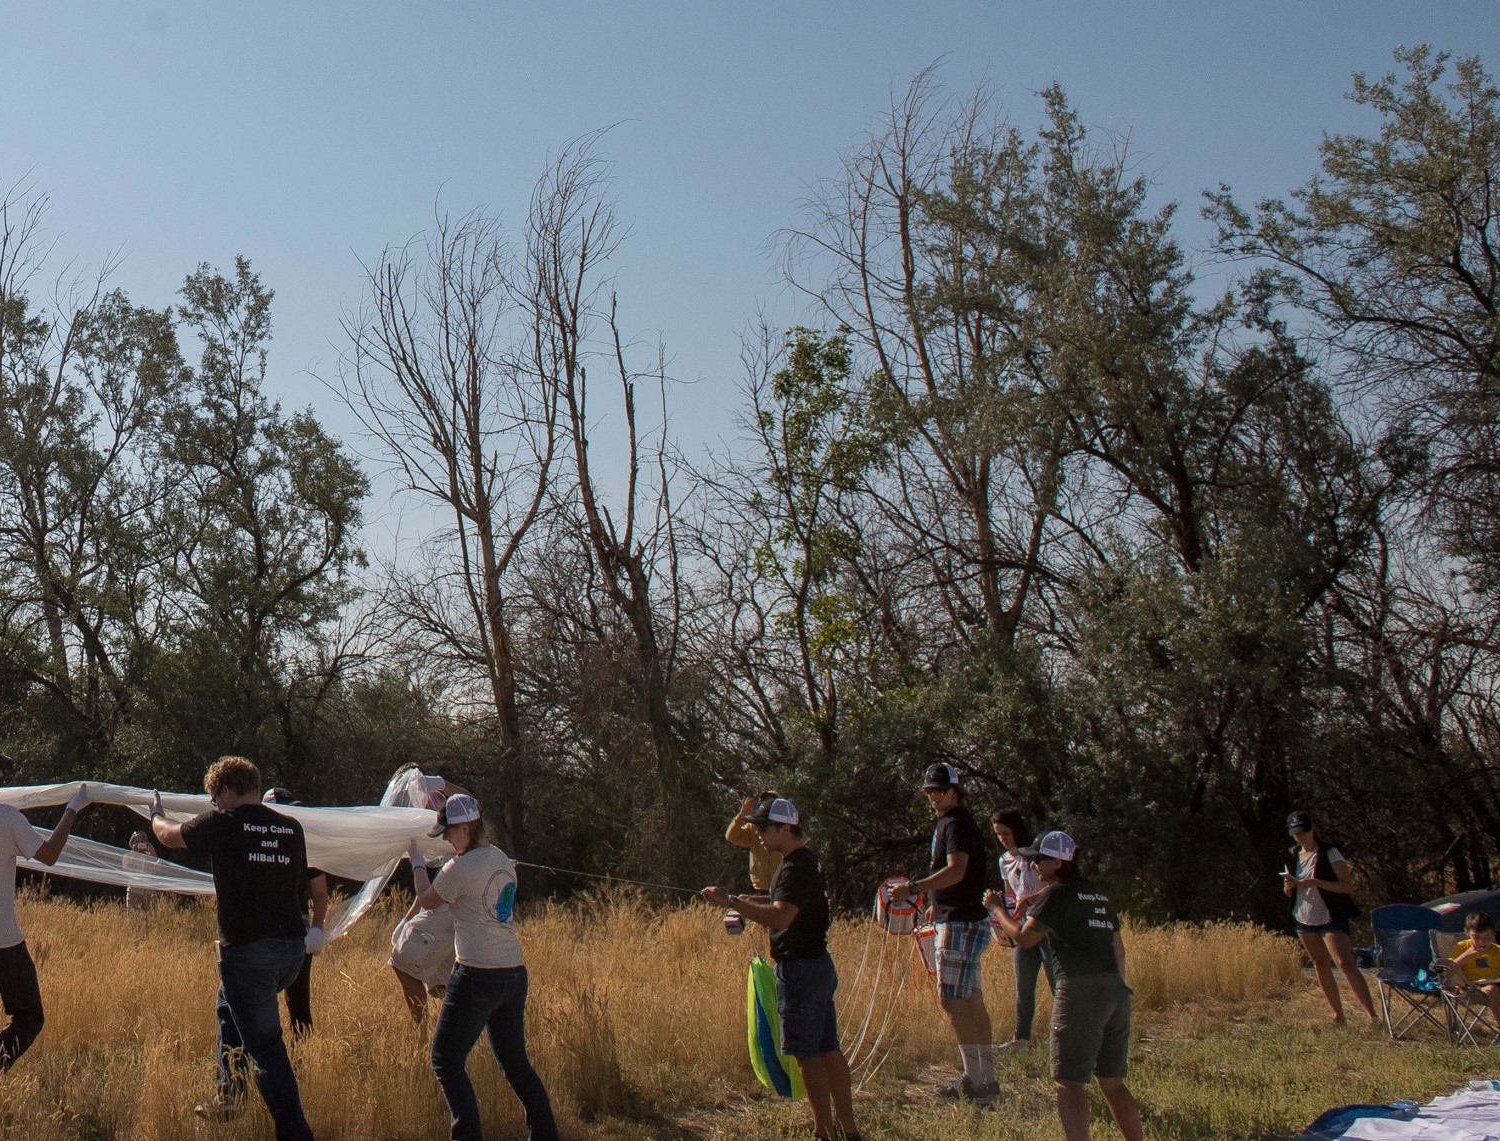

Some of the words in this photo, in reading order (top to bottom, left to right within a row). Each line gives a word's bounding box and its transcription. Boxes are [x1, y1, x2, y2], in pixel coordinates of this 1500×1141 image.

[243, 823, 268, 834] Keep
[270, 825, 294, 835] Calm
[261, 840, 279, 848] and
[248, 853, 275, 863] HiBal
[277, 855, 290, 865] Up
[1077, 893, 1095, 902] Keep
